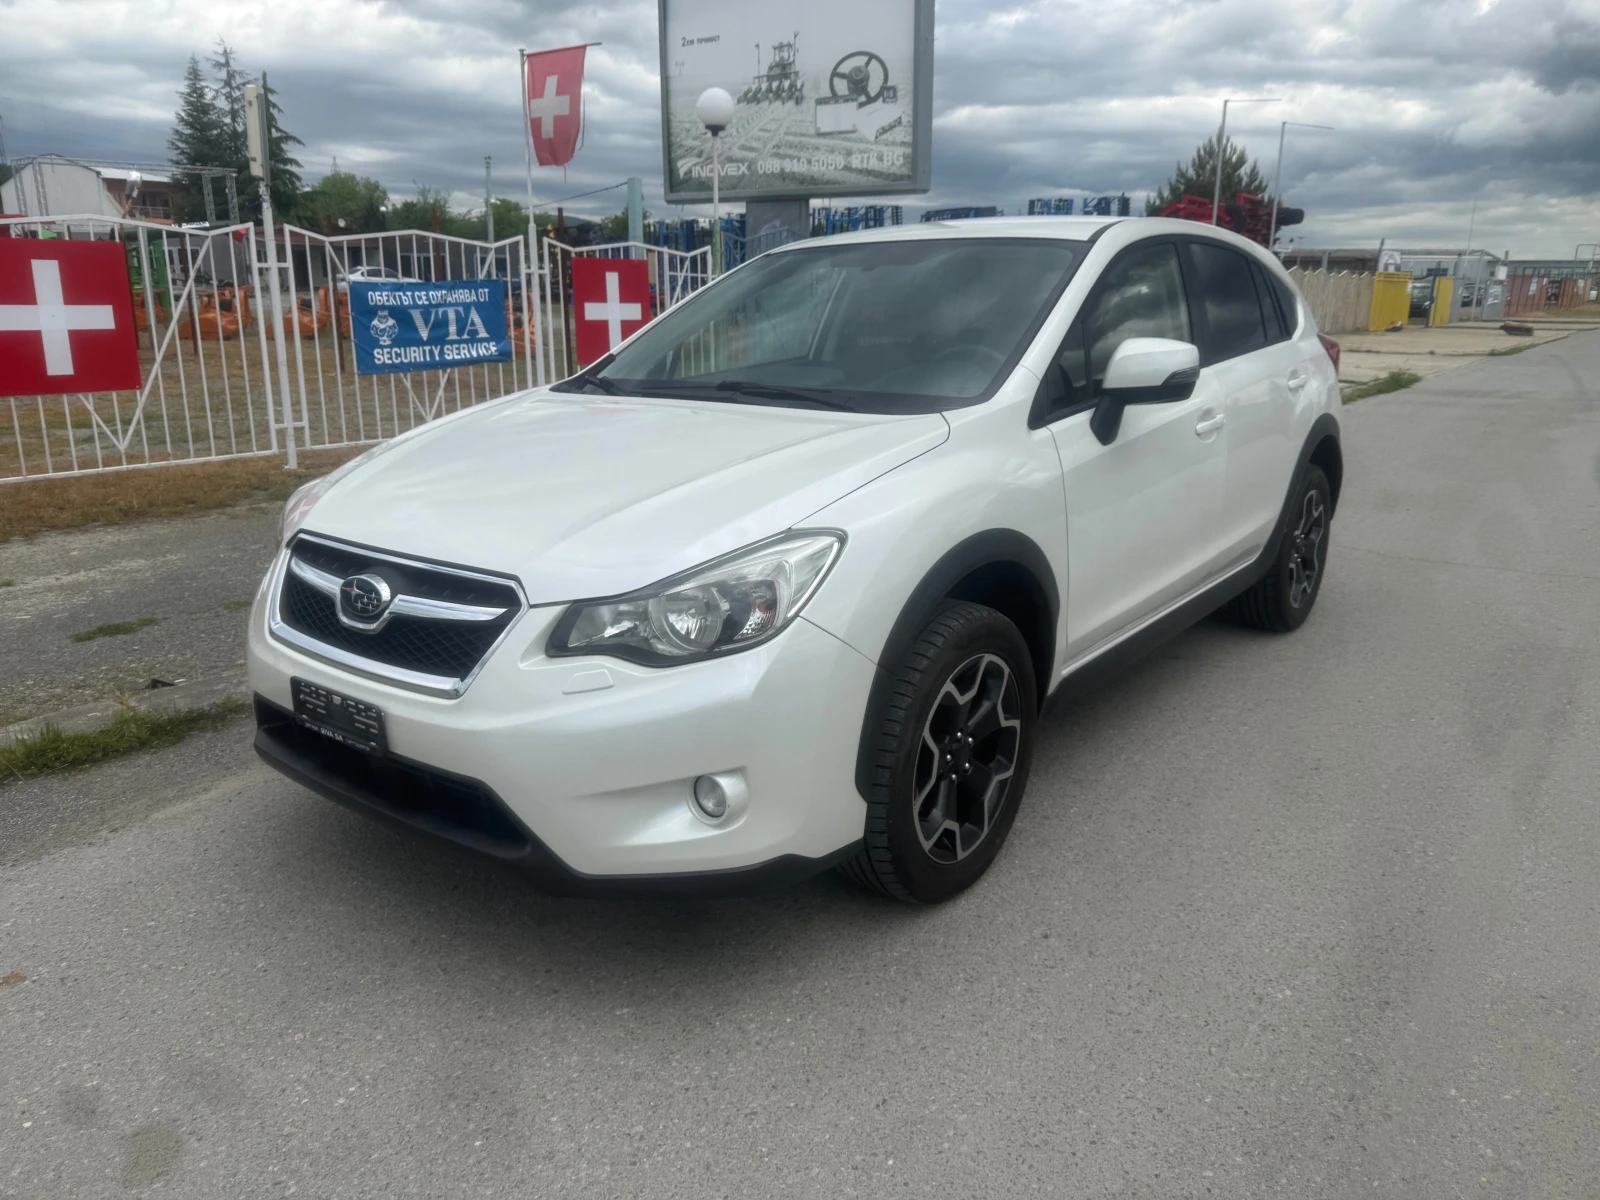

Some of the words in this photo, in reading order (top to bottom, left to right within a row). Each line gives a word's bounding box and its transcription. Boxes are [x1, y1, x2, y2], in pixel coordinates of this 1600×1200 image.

[691, 161, 749, 178] INOVEX
[757, 159, 780, 174] 088
[811, 155, 844, 171] 5050
[368, 290, 414, 306] ОБЕКТЪТ
[414, 290, 428, 305] СЕ
[429, 288, 477, 305] ОХРАНЯВА
[478, 288, 490, 302] ОТ
[408, 305, 491, 342] VTA
[373, 345, 441, 364] SECURITY
[444, 341, 499, 361] SERVICE
